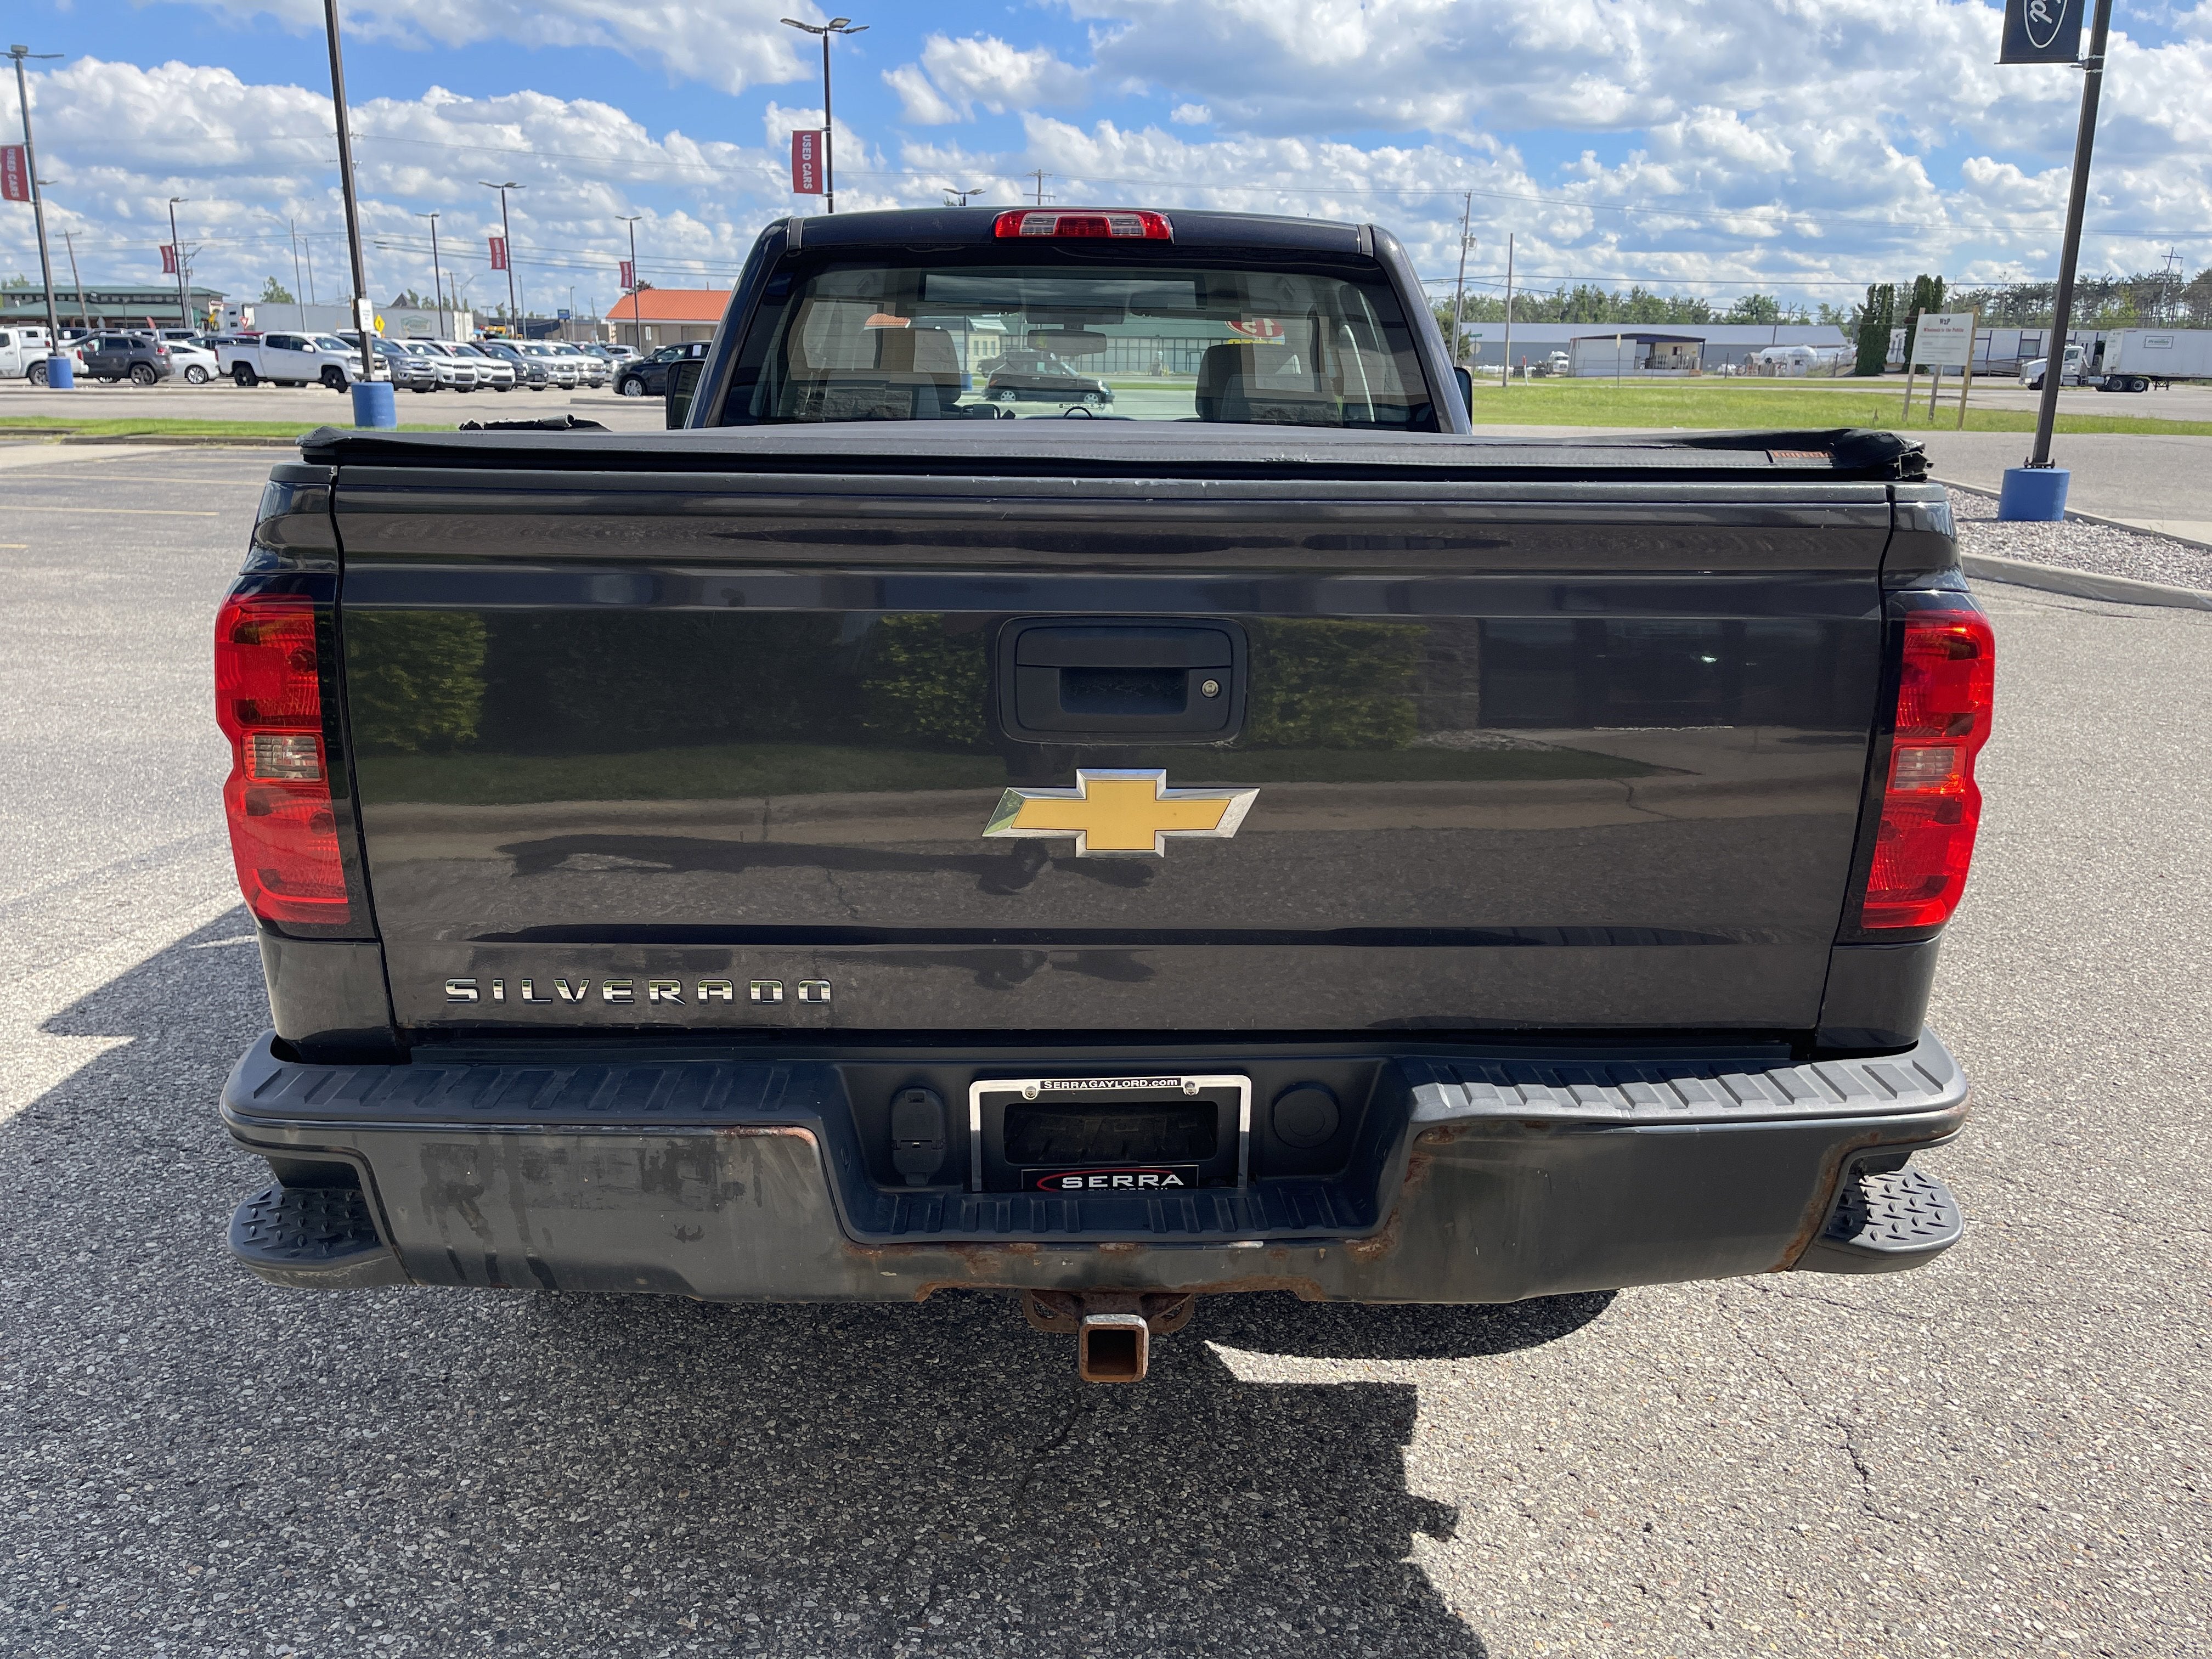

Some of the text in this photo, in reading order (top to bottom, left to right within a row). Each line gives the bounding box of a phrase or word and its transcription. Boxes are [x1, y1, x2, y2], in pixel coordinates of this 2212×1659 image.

[7, 148, 19, 198] USED CARS
[802, 134, 813, 189] USED CARS
[445, 978, 832, 1005] SILVERADO
[1044, 1079, 1178, 1088] SERRAGAYLORD.com
[1062, 1173, 1184, 1188] SERRA
